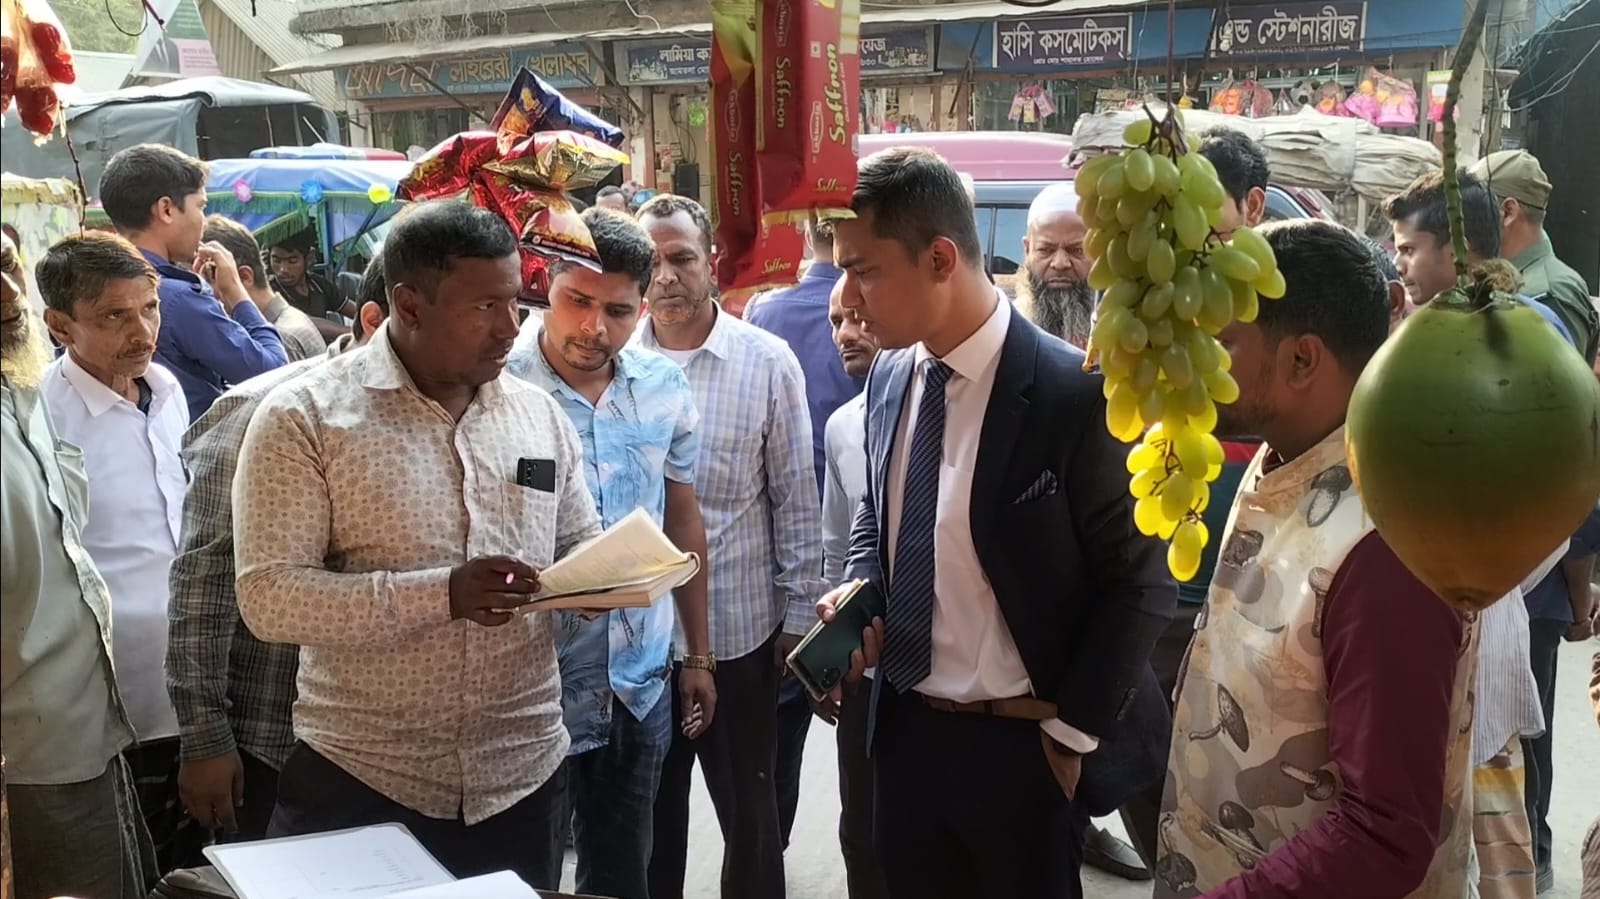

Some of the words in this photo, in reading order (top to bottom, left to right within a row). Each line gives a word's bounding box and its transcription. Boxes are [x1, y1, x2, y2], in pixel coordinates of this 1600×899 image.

[1001, 21, 1035, 61] হাসি
[1258, 5, 1359, 45] স্টেশনারীজ
[659, 44, 695, 62] লামিয়া
[776, 56, 791, 129] Saffron
[825, 43, 846, 145] Saffron
[728, 152, 744, 216] Saffron
[815, 177, 848, 192] Saffron
[762, 257, 793, 274] Saffron
